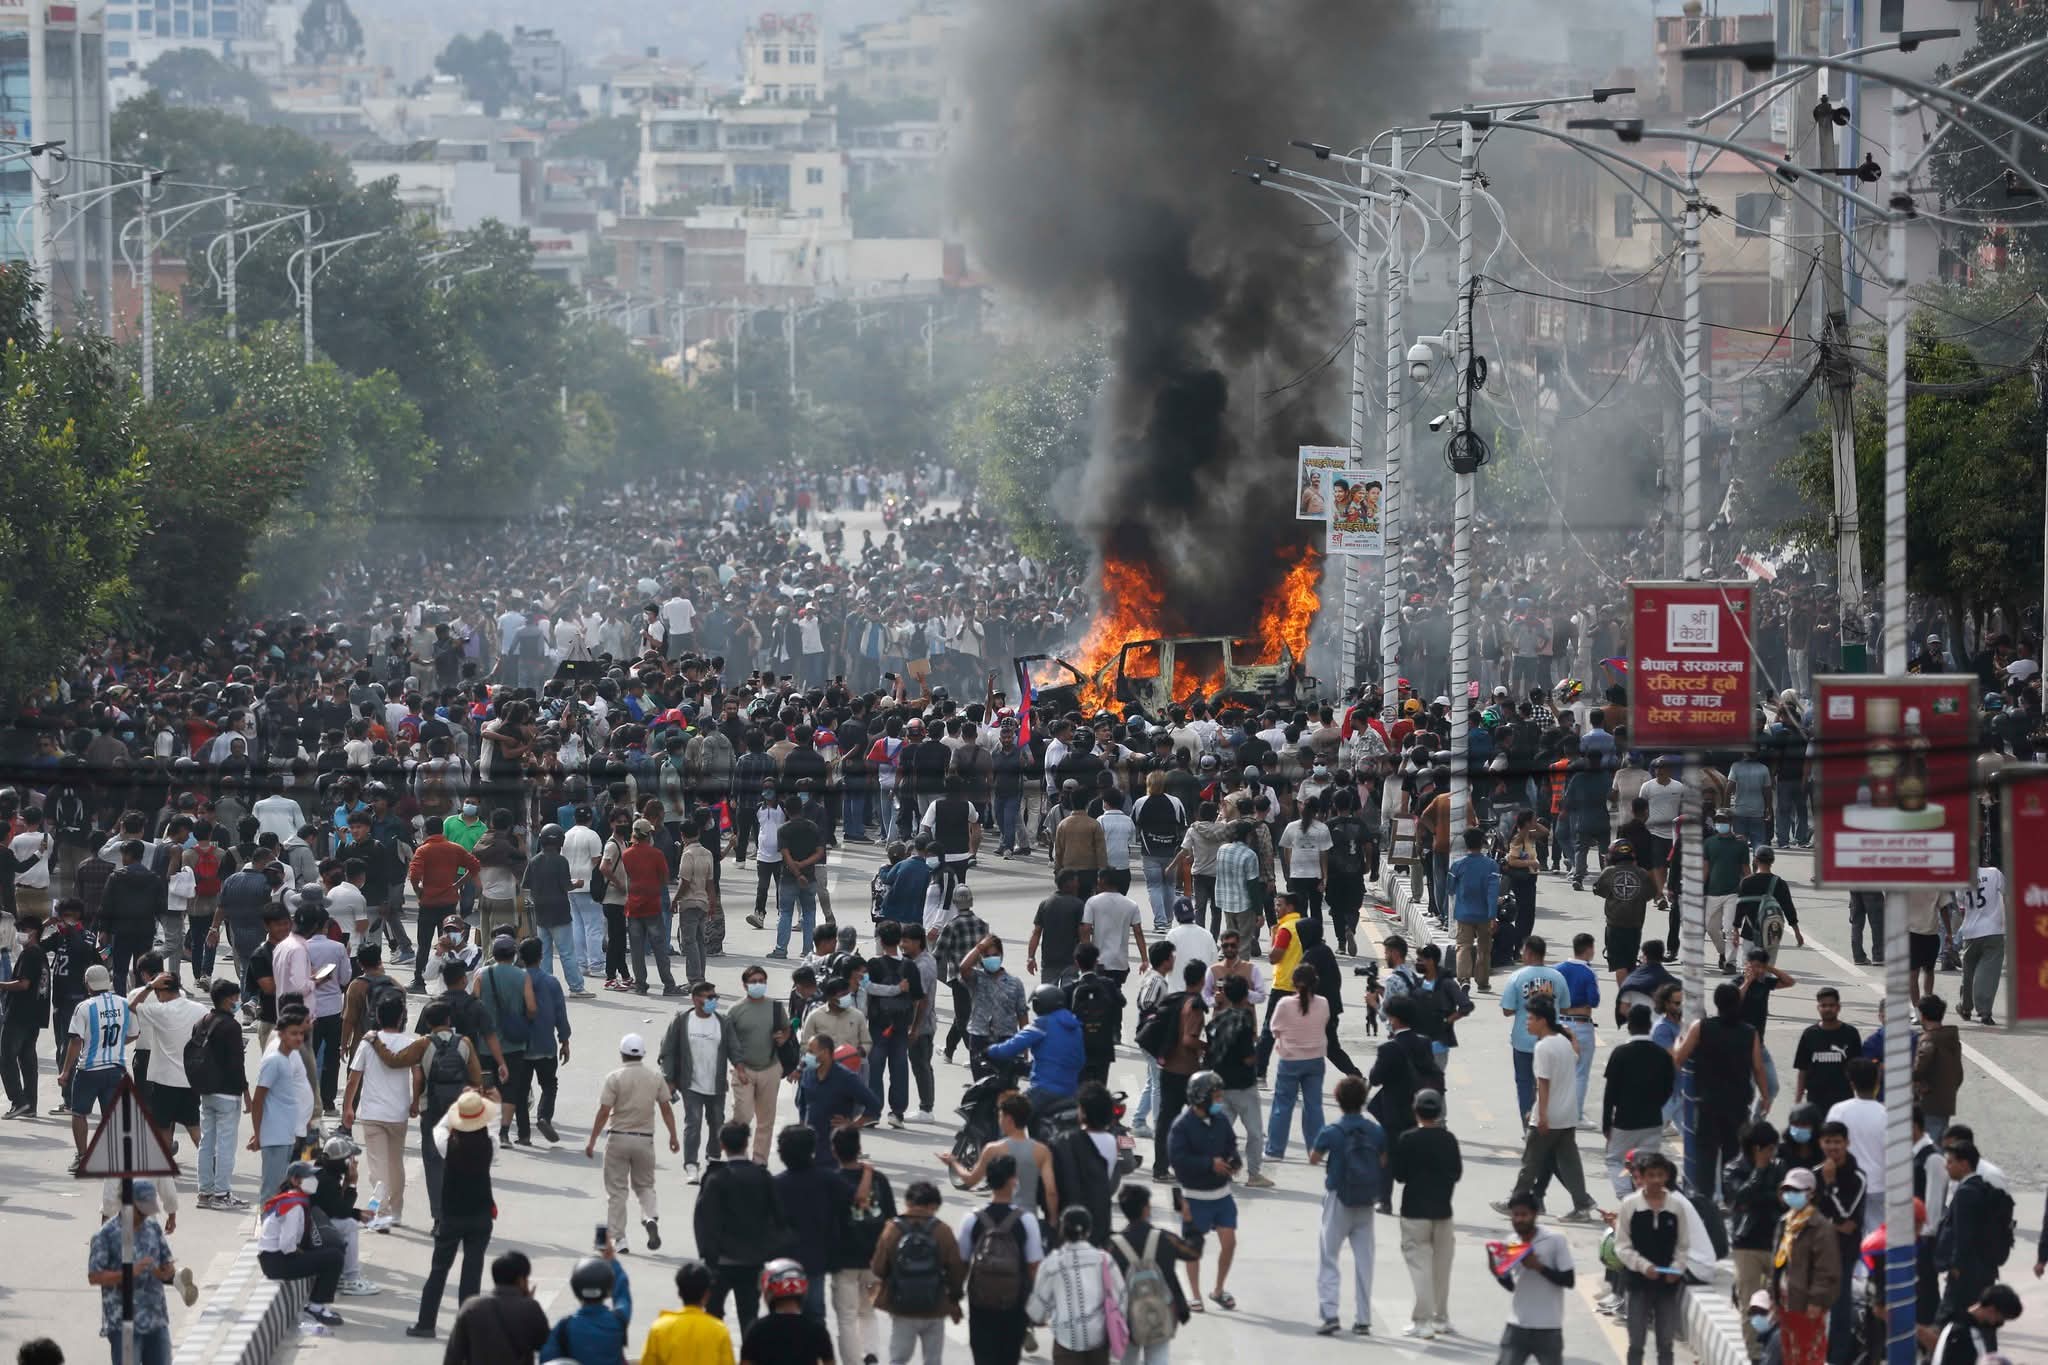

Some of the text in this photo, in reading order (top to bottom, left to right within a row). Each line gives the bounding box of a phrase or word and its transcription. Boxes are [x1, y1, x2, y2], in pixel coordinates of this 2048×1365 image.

[1691, 609, 1708, 625] श्री
[1679, 625, 1709, 640] केश
[1641, 657, 1744, 672] नेपाल सरकारमा
[1647, 674, 1738, 693] रजिस्टर्ड हुने
[1662, 694, 1723, 707] एक मात्र
[1648, 706, 1736, 723] हेयर आयल
[1966, 887, 1987, 909] 15
[100, 1008, 121, 1019] MESSI
[101, 1023, 121, 1049] 10
[1812, 1051, 1842, 1063] PUMA
